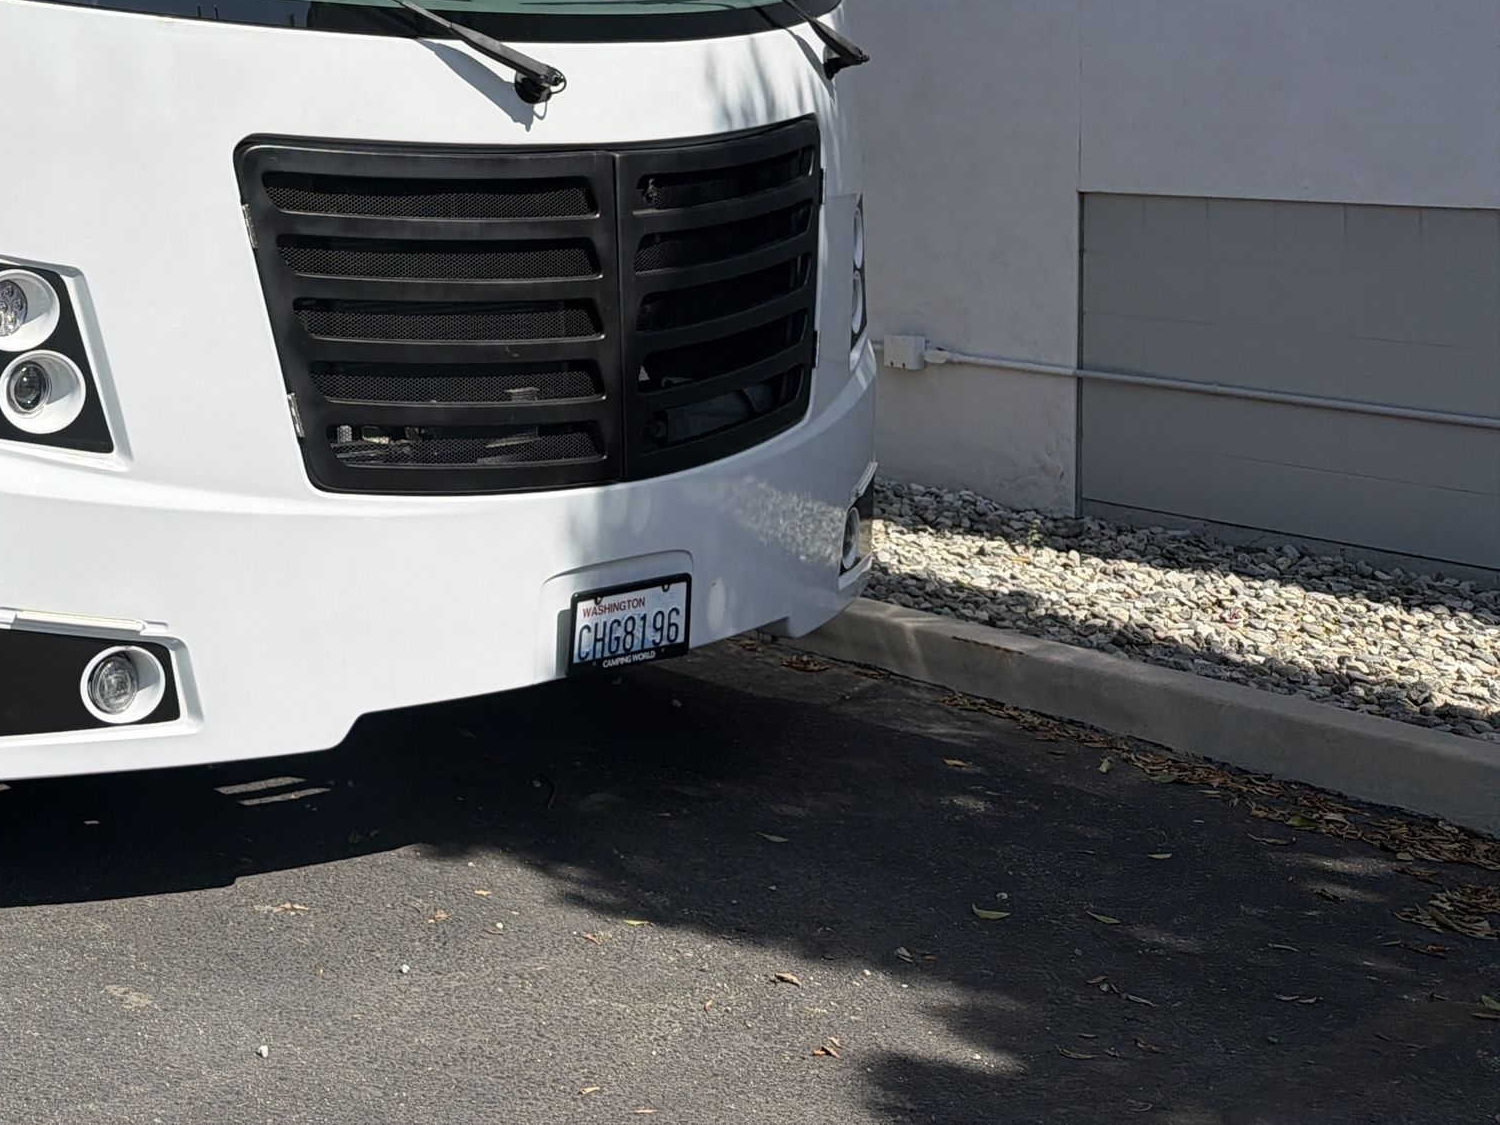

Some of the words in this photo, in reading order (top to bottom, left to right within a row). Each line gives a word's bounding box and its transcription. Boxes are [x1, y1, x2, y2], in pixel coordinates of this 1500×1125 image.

[583, 597, 645, 618] WASHINGTON
[578, 607, 679, 661] CHG8196
[602, 656, 632, 668] CAMPING
[632, 651, 656, 661] WORLD
